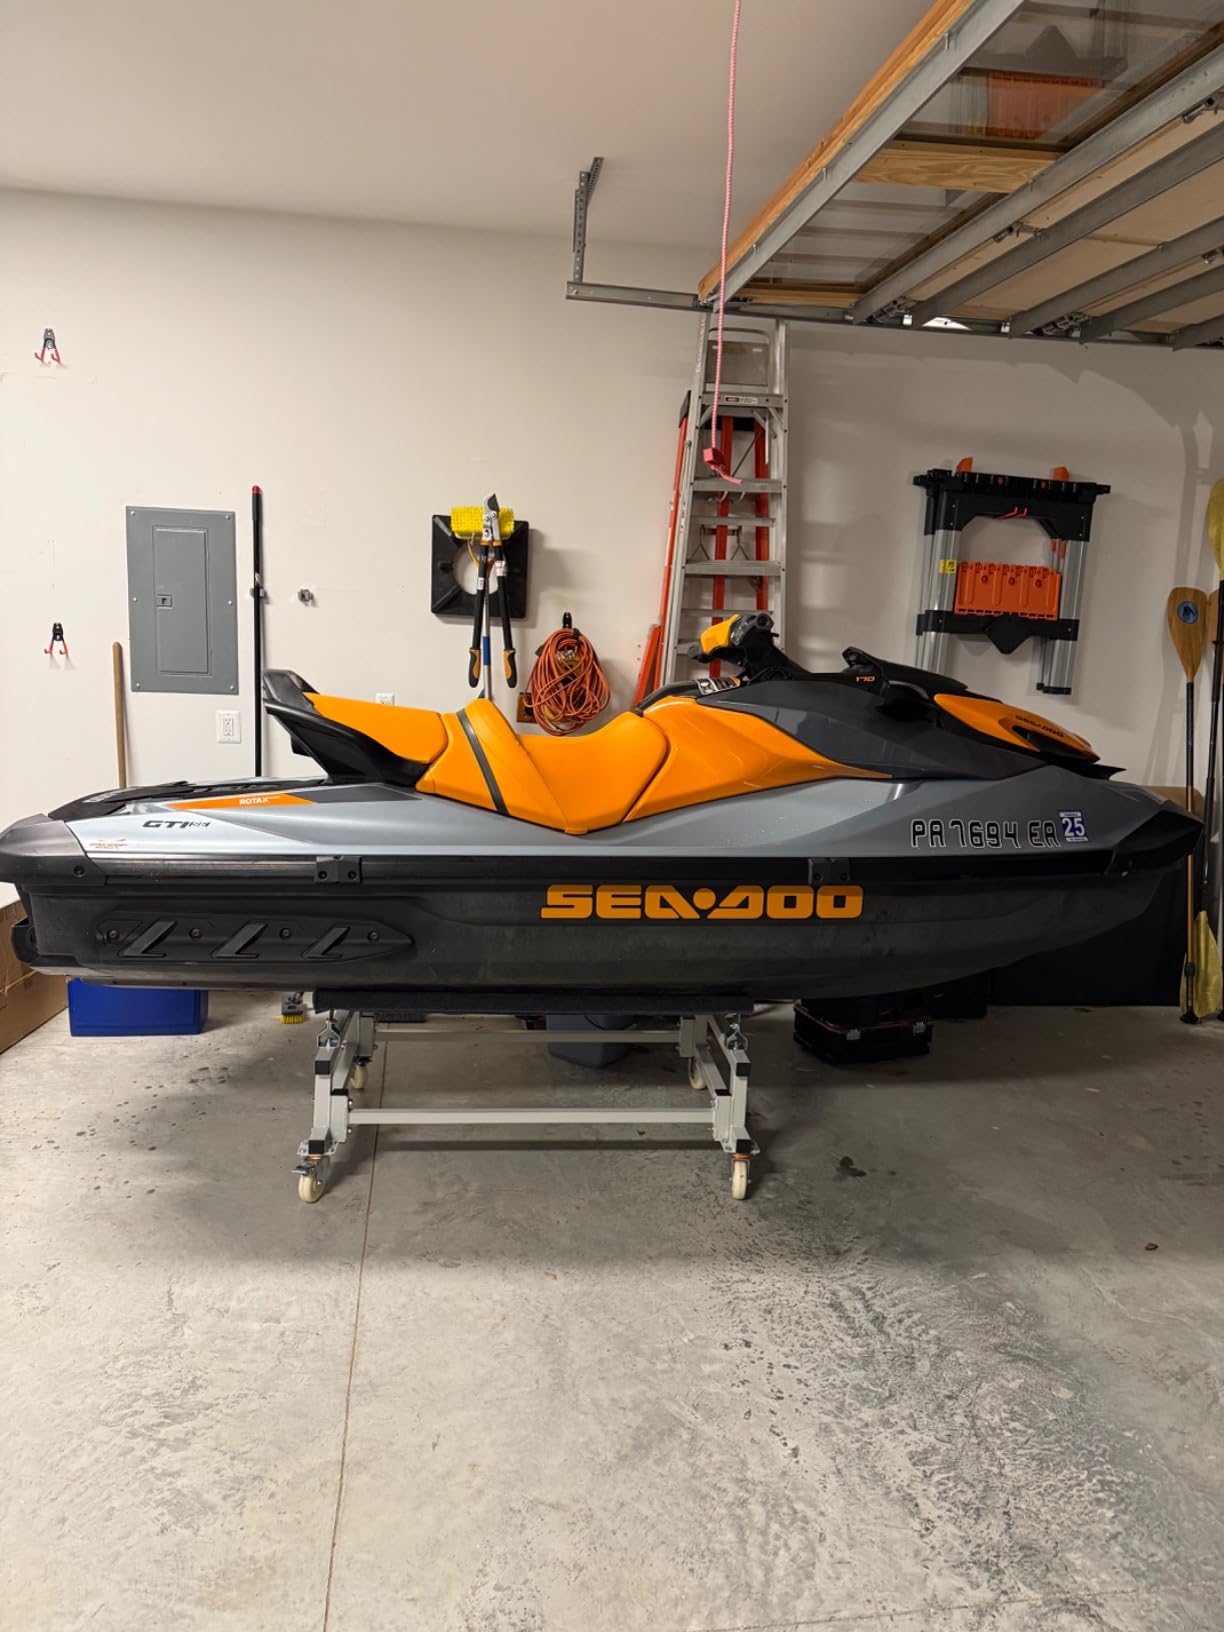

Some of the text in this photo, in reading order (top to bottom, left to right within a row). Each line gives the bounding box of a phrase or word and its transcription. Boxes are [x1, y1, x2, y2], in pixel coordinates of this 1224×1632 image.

[239, 797, 269, 806] ROTAX
[142, 820, 190, 829] GTI
[1062, 817, 1085, 837] 25
[911, 818, 1062, 849] PA 7694 ER
